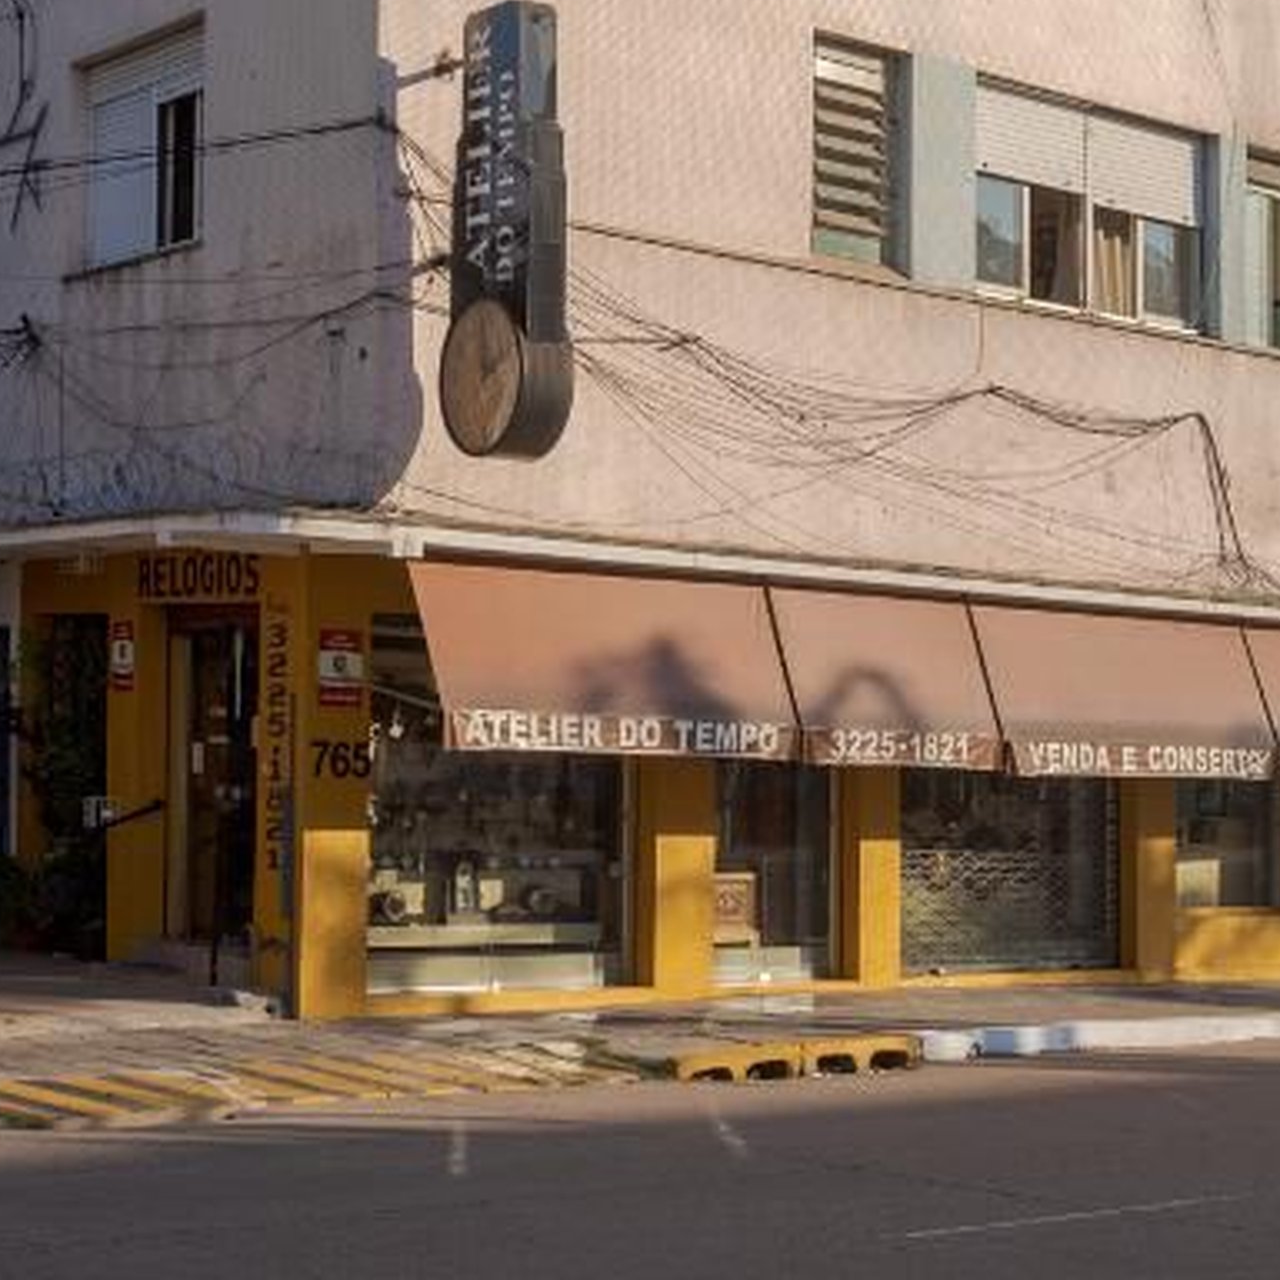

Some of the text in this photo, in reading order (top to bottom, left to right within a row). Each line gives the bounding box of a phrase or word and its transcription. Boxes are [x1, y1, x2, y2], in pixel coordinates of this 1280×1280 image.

[466, 715, 779, 754] ATELIER DO TEMPO
[310, 740, 371, 778] 765
[1029, 742, 1110, 771] VENDA
[1122, 746, 1137, 771] E
